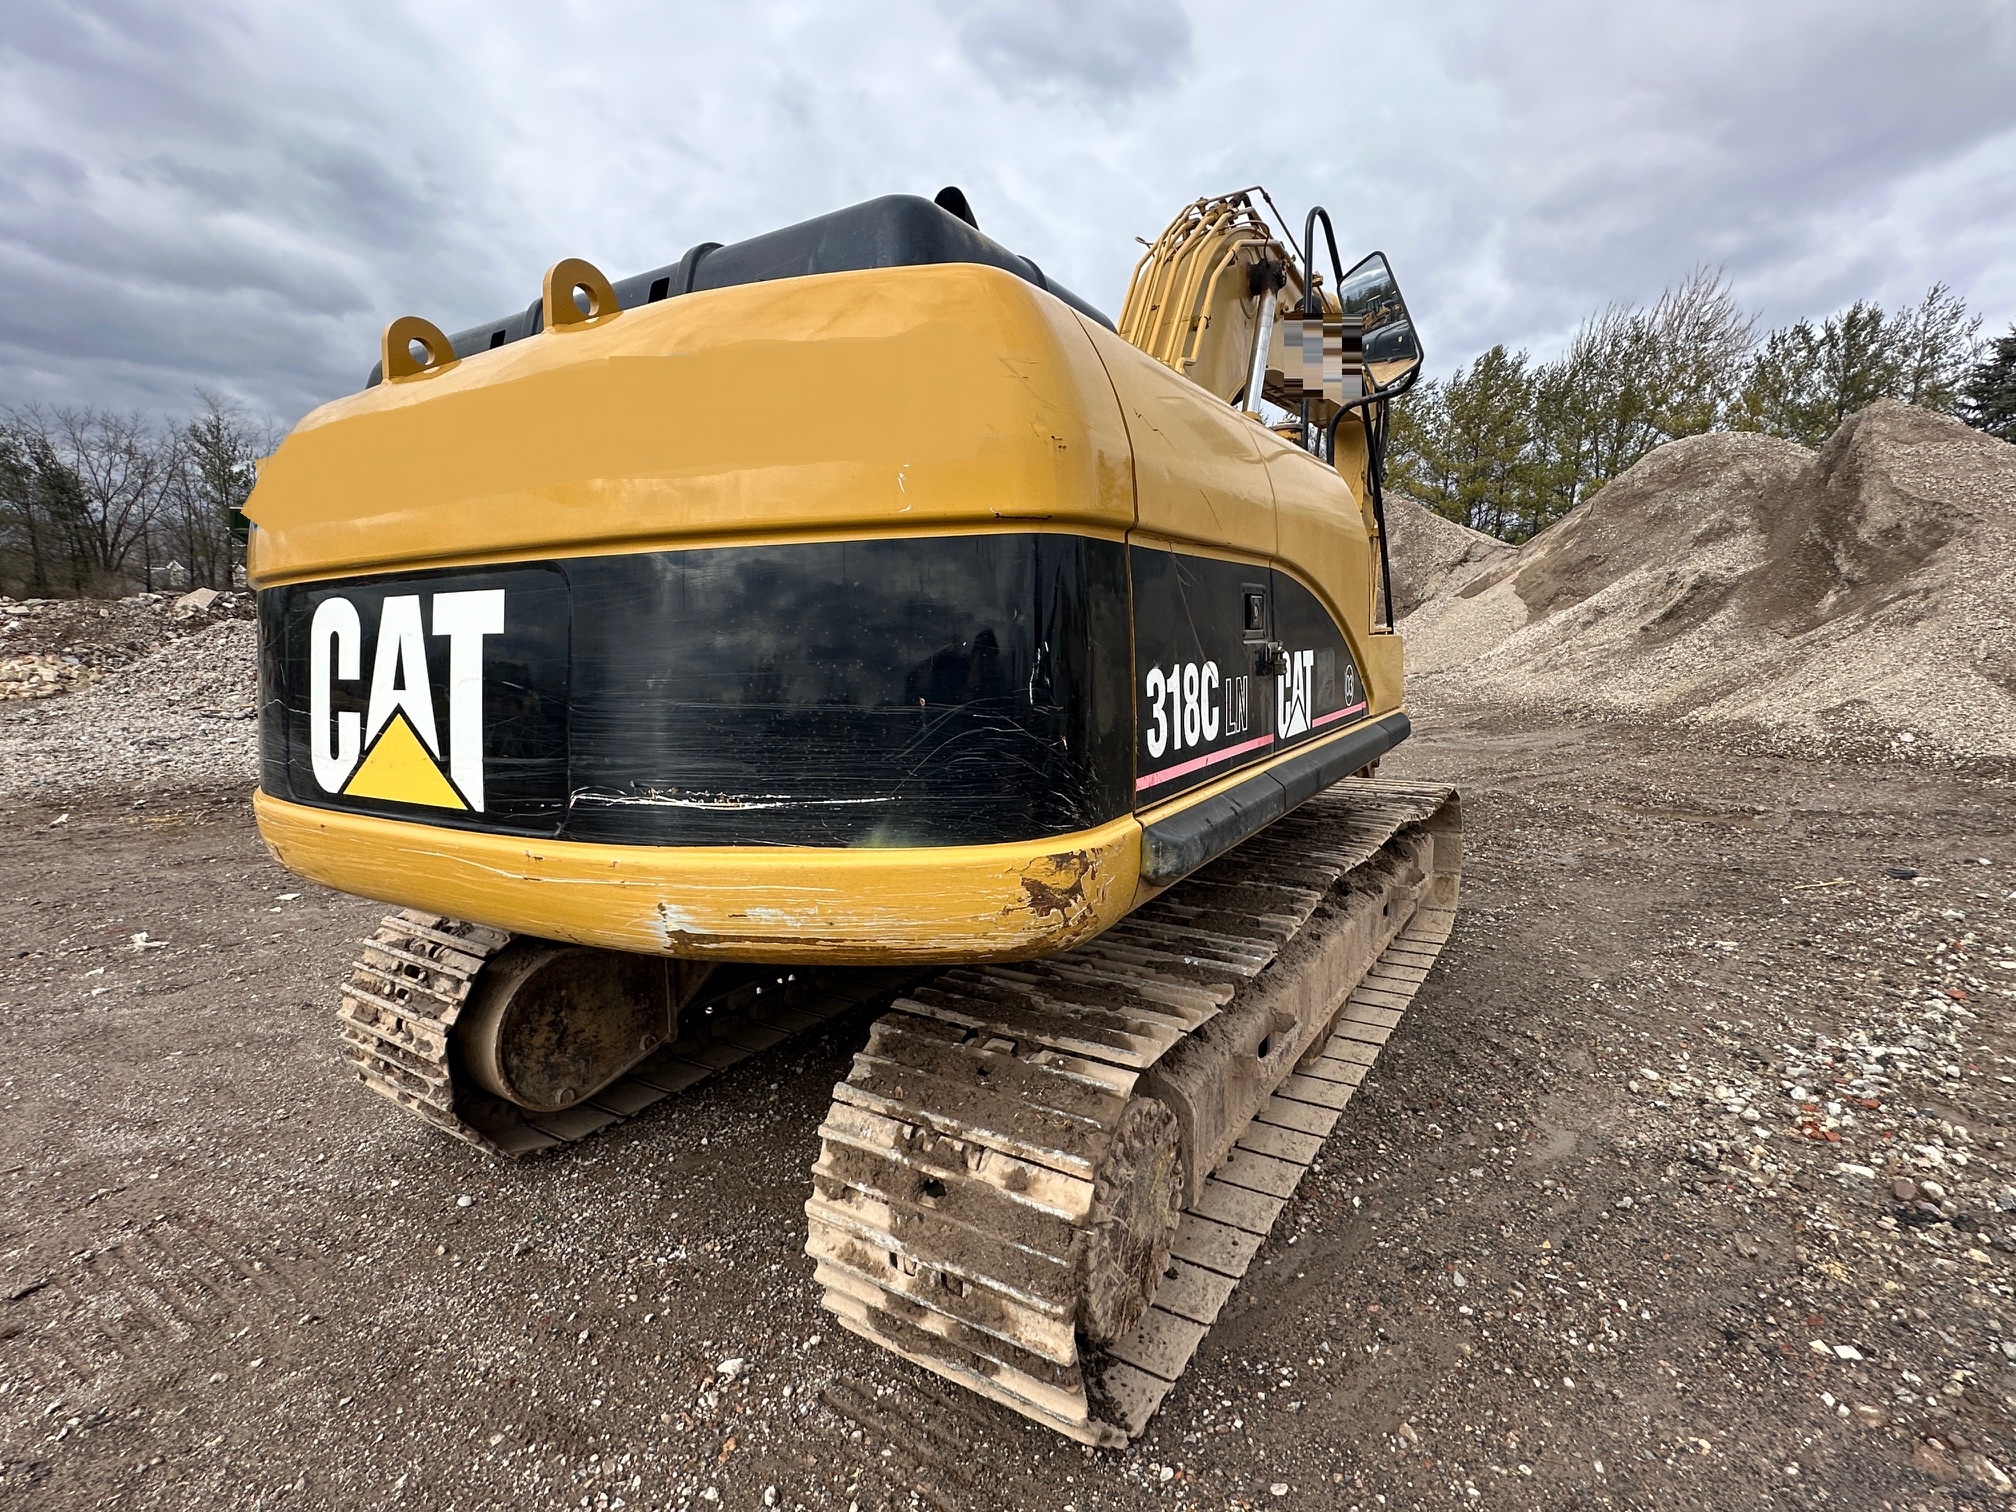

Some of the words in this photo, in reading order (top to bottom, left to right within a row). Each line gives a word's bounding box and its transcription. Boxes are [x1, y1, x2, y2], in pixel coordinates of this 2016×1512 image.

[310, 589, 505, 813] CAT
[1146, 661, 1219, 758] 318C
[1225, 675, 1248, 736] LN
[1277, 649, 1314, 740] CAT
